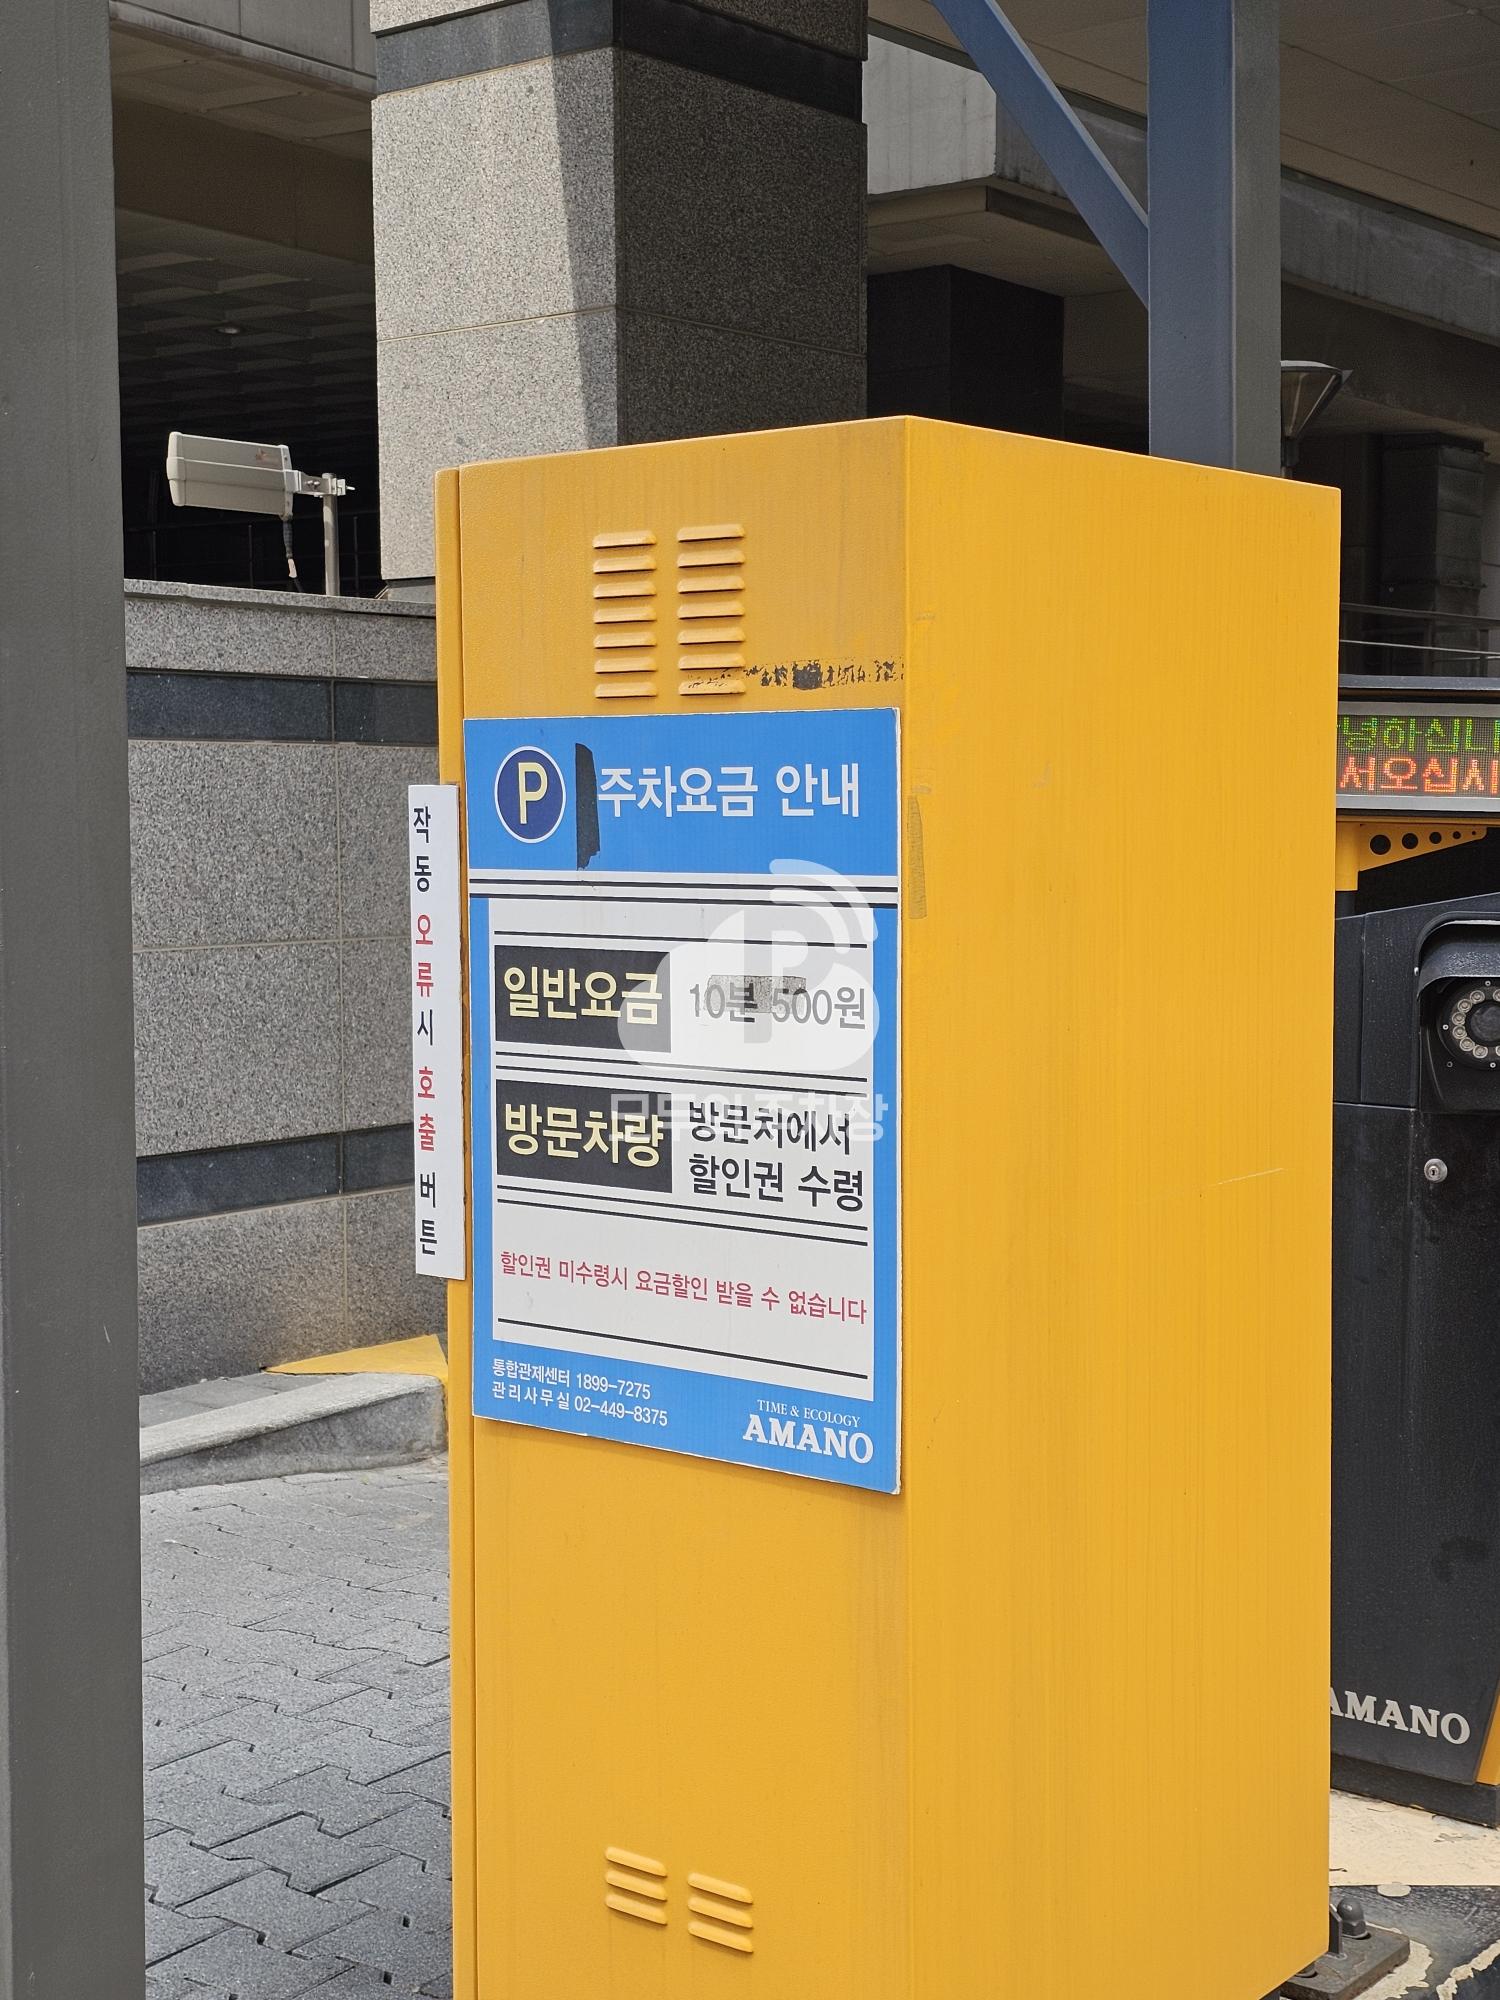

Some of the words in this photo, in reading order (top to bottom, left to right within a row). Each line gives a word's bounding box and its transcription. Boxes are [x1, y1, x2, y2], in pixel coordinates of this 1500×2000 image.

[1337, 717, 1500, 753] 녕하십니
[518, 761, 548, 825] P
[598, 764, 759, 818] 주차요금
[775, 763, 860, 818] 안내
[413, 805, 432, 893] 작동
[503, 966, 664, 1026] 일반요금
[690, 982, 758, 1023] 10분
[772, 987, 866, 1030] 500원
[504, 1102, 664, 1168] 방문차량
[689, 1101, 851, 1156] 방문처에서
[689, 1152, 784, 1203] 할인권
[797, 1164, 864, 1213] 수령
[500, 1251, 551, 1280] 할인권
[559, 1259, 628, 1291] 미수령시
[635, 1270, 708, 1302] 요금할인
[716, 1280, 753, 1308] 받을
[760, 1287, 780, 1311] 수
[788, 1289, 867, 1325] 없습니다
[492, 1358, 570, 1388] 통합관제센터
[576, 1373, 651, 1400] 1899-7275
[574, 1396, 668, 1427] 02-449-8375
[742, 1413, 874, 1464] AMANO
[757, 1399, 788, 1416] TIME
[790, 1405, 800, 1418] &
[803, 1407, 861, 1428] ECOLOGY
